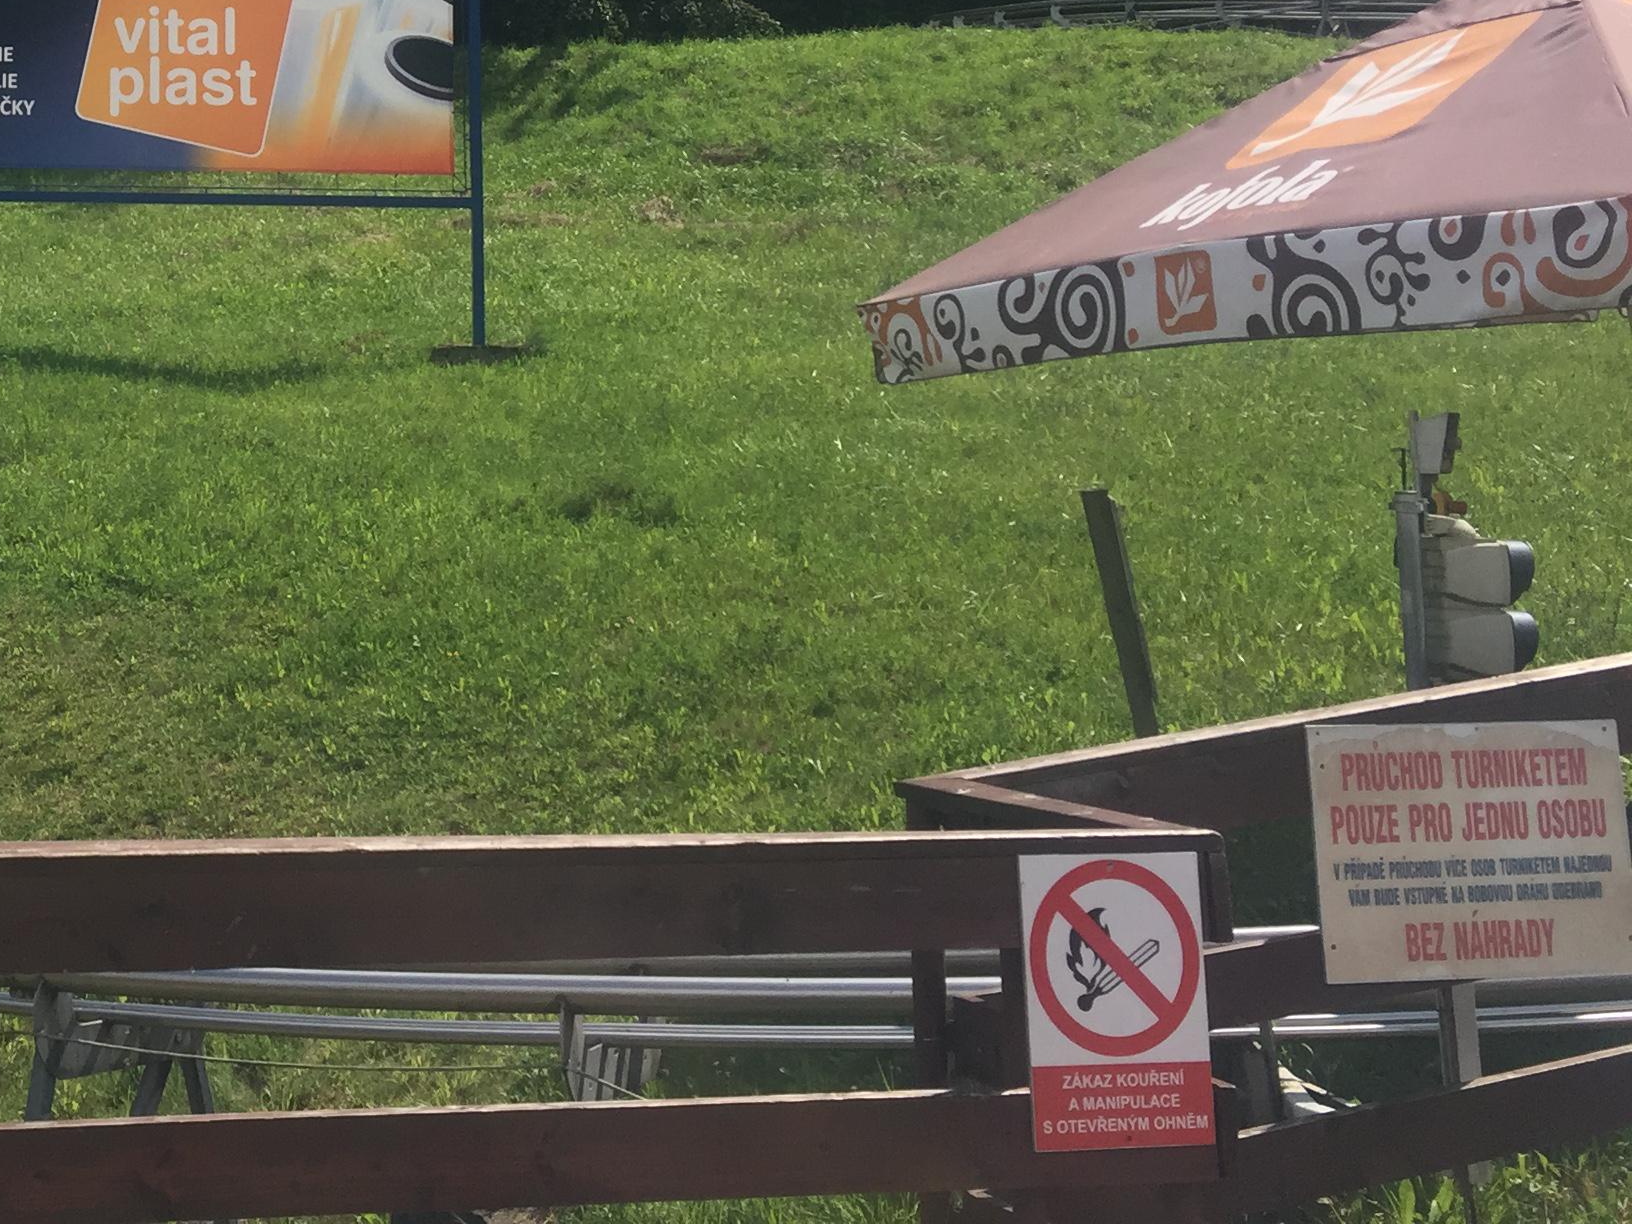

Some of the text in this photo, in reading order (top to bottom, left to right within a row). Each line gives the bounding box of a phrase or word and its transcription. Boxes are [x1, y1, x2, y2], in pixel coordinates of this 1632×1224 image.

[114, 6, 236, 56] vital
[109, 55, 257, 117] plast
[1139, 158, 1338, 231] kofola
[1340, 741, 1589, 792] PRŮCHOD TURNIKETEM
[1330, 798, 1608, 845] POUZE PRO JEDNU OSOBU
[1333, 863, 1340, 880] V
[1470, 858, 1496, 877] OSOB
[1499, 856, 1560, 876] TURNIKETEM
[1451, 886, 1465, 904] NA
[1467, 884, 1513, 903] BOBOVOU
[1405, 909, 1554, 962] BEZ NÁHRADY
[1062, 1068, 1185, 1090] ZÁKAZ KOUŘENÍ
[1069, 1093, 1181, 1111] A MANIPULACE
[1043, 1112, 1209, 1134] S OTEVŘENÝM OHNĚM
